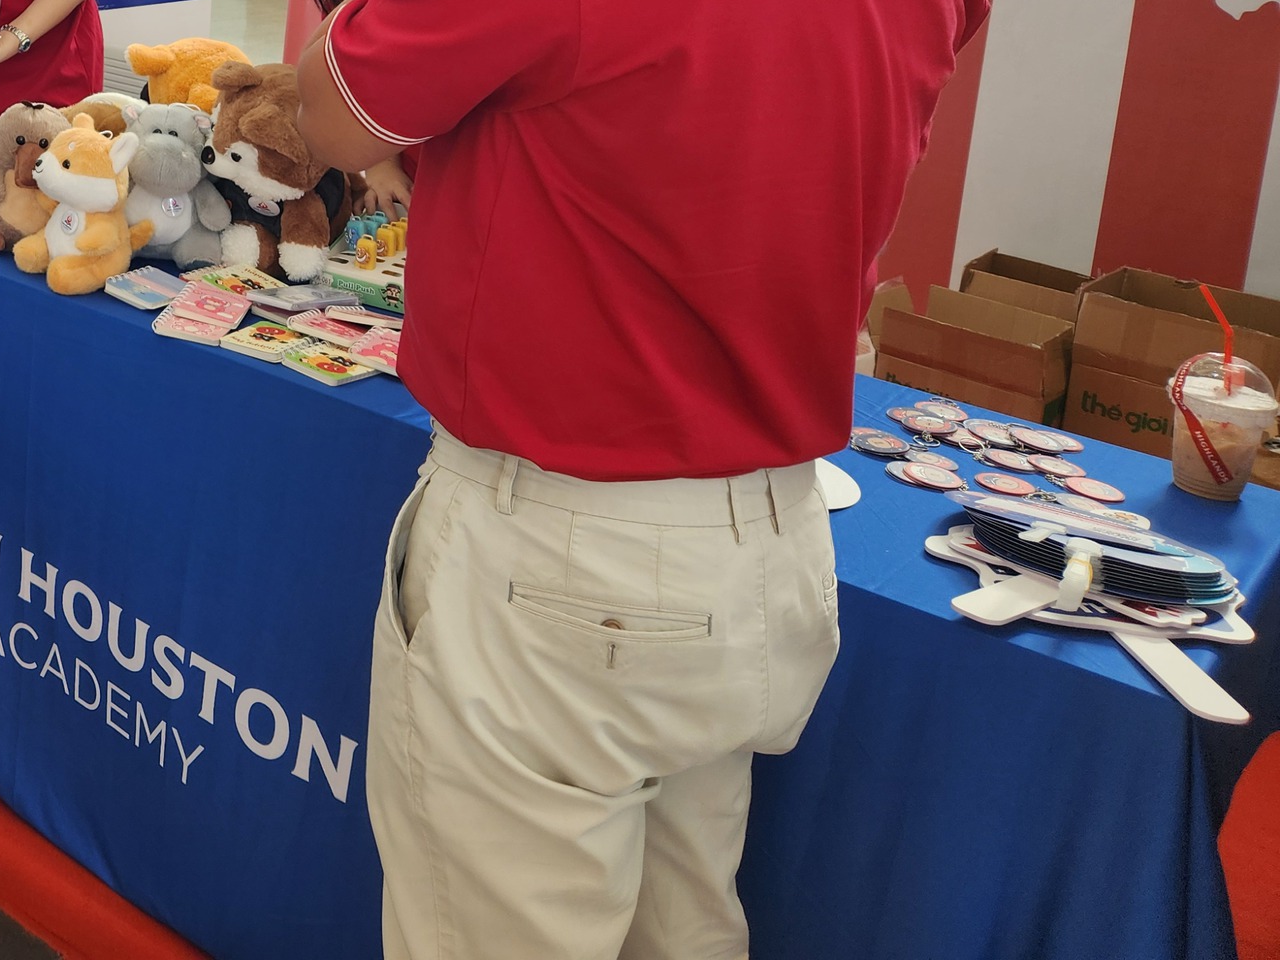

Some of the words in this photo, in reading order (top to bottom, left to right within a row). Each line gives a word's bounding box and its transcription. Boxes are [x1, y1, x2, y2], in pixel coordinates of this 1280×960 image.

[355, 284, 376, 296] Push
[1194, 430, 1229, 483] HIGHLANDS
[17, 546, 360, 804] HOUSTON
